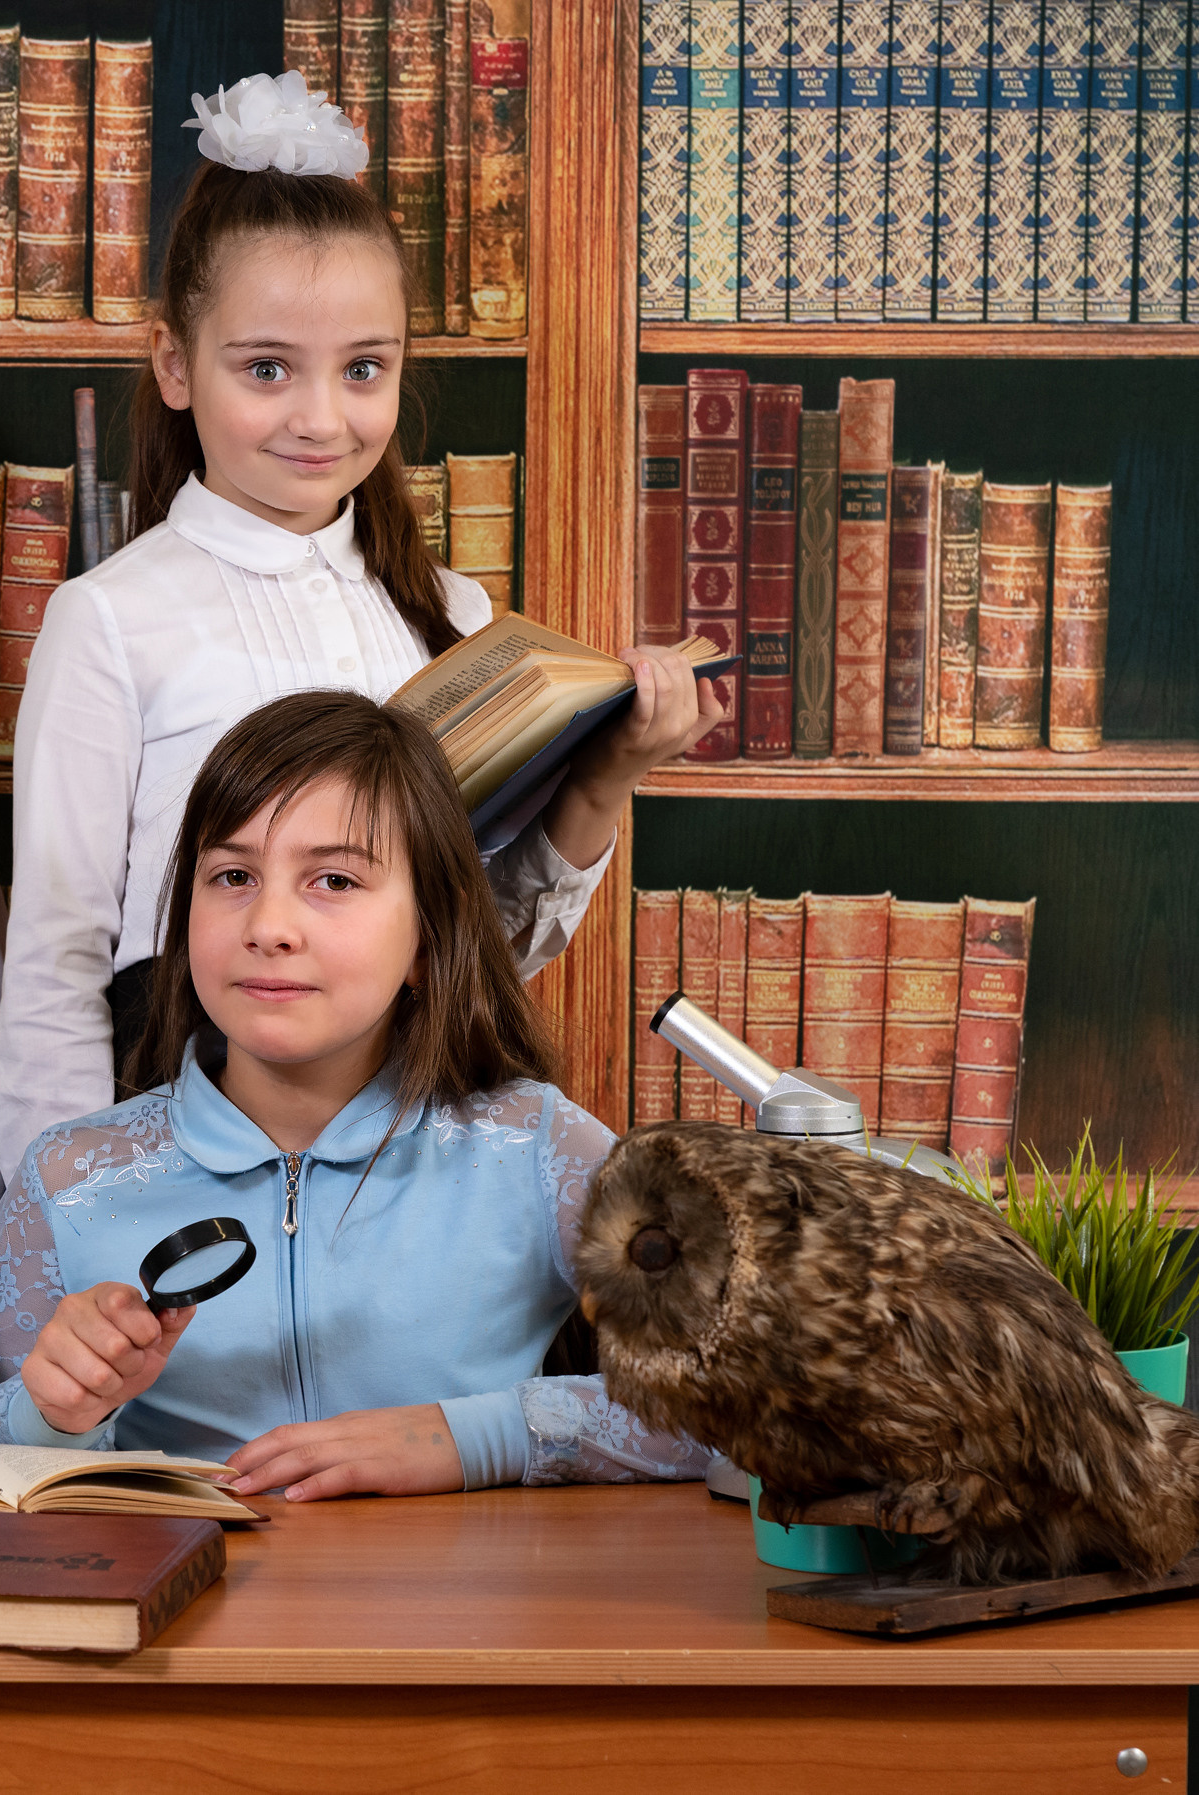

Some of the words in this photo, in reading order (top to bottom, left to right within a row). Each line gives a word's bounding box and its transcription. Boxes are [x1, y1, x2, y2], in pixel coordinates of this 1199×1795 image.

[764, 477, 783, 487] LEO
[754, 489, 791, 499] TOLSTOY
[846, 502, 862, 512] BEN
[865, 502, 882, 512] HUR
[754, 642, 784, 653] ANNA
